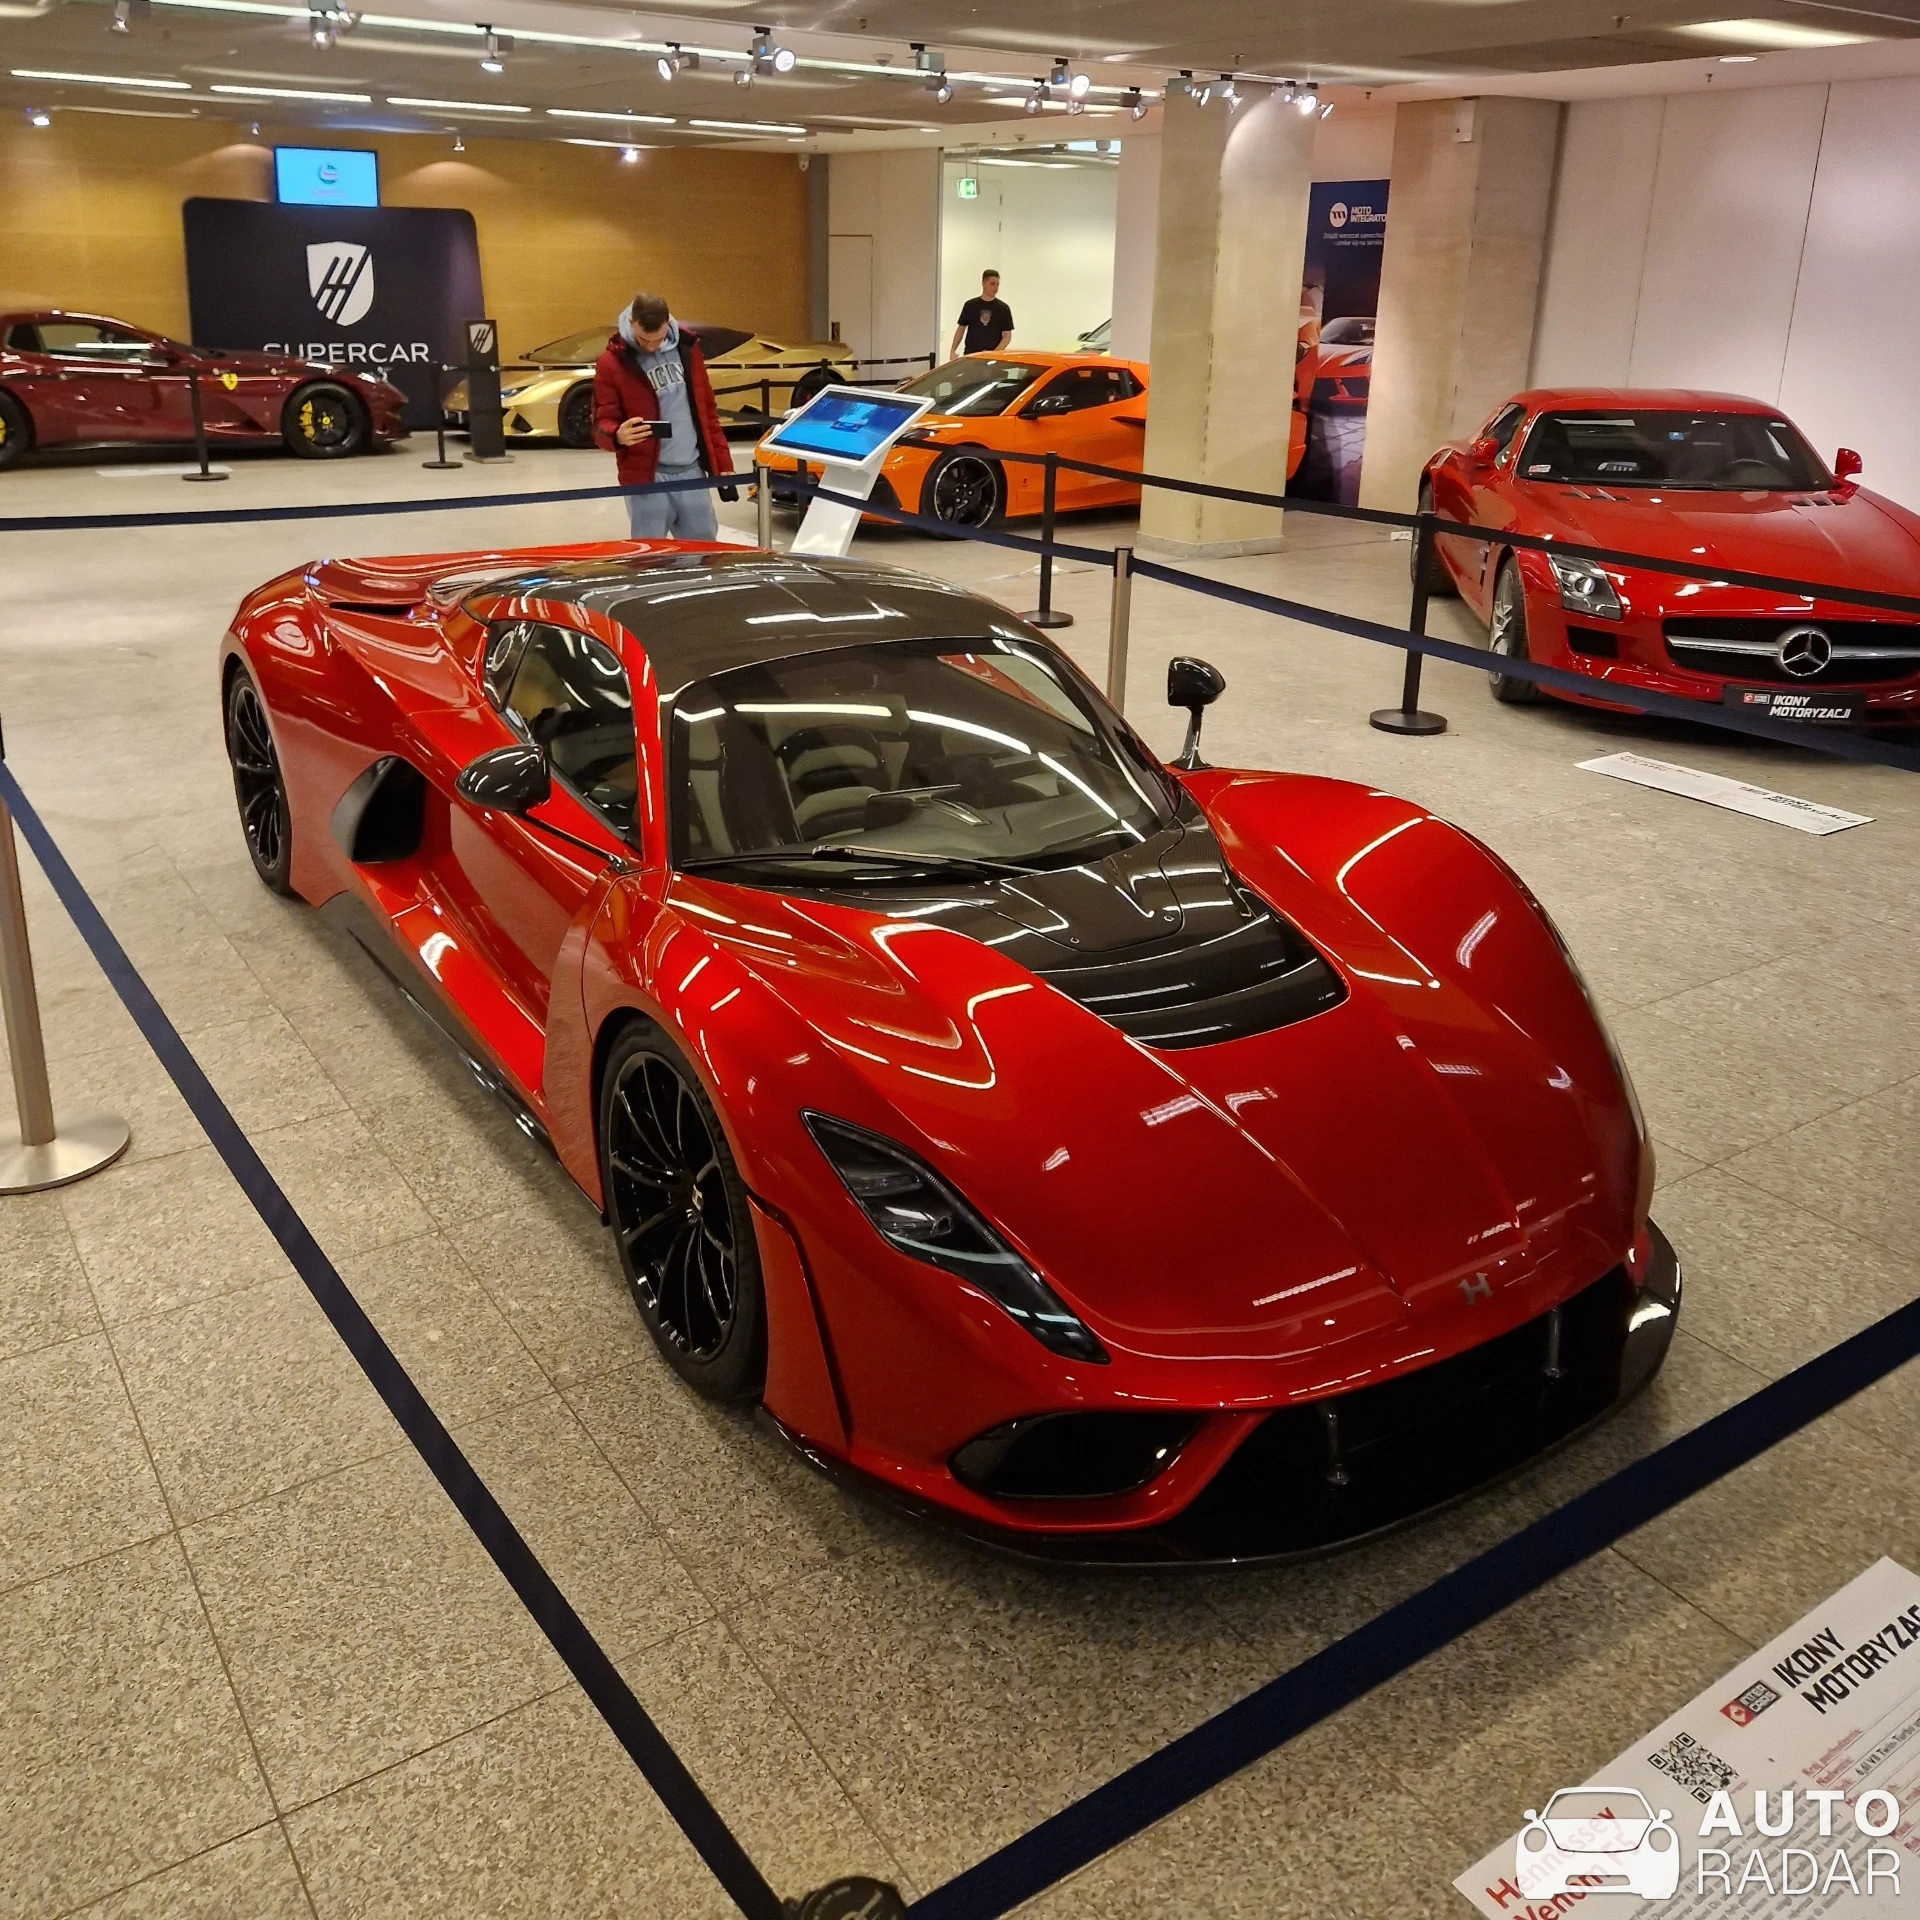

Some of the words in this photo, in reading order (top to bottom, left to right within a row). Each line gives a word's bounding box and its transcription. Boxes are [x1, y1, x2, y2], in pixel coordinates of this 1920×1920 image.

[1351, 206, 1372, 215] MOTO
[1773, 695, 1811, 706] IKONY
[1769, 706, 1852, 719] MOTORYZACJI
[1772, 1626, 1846, 1690] IKONY
